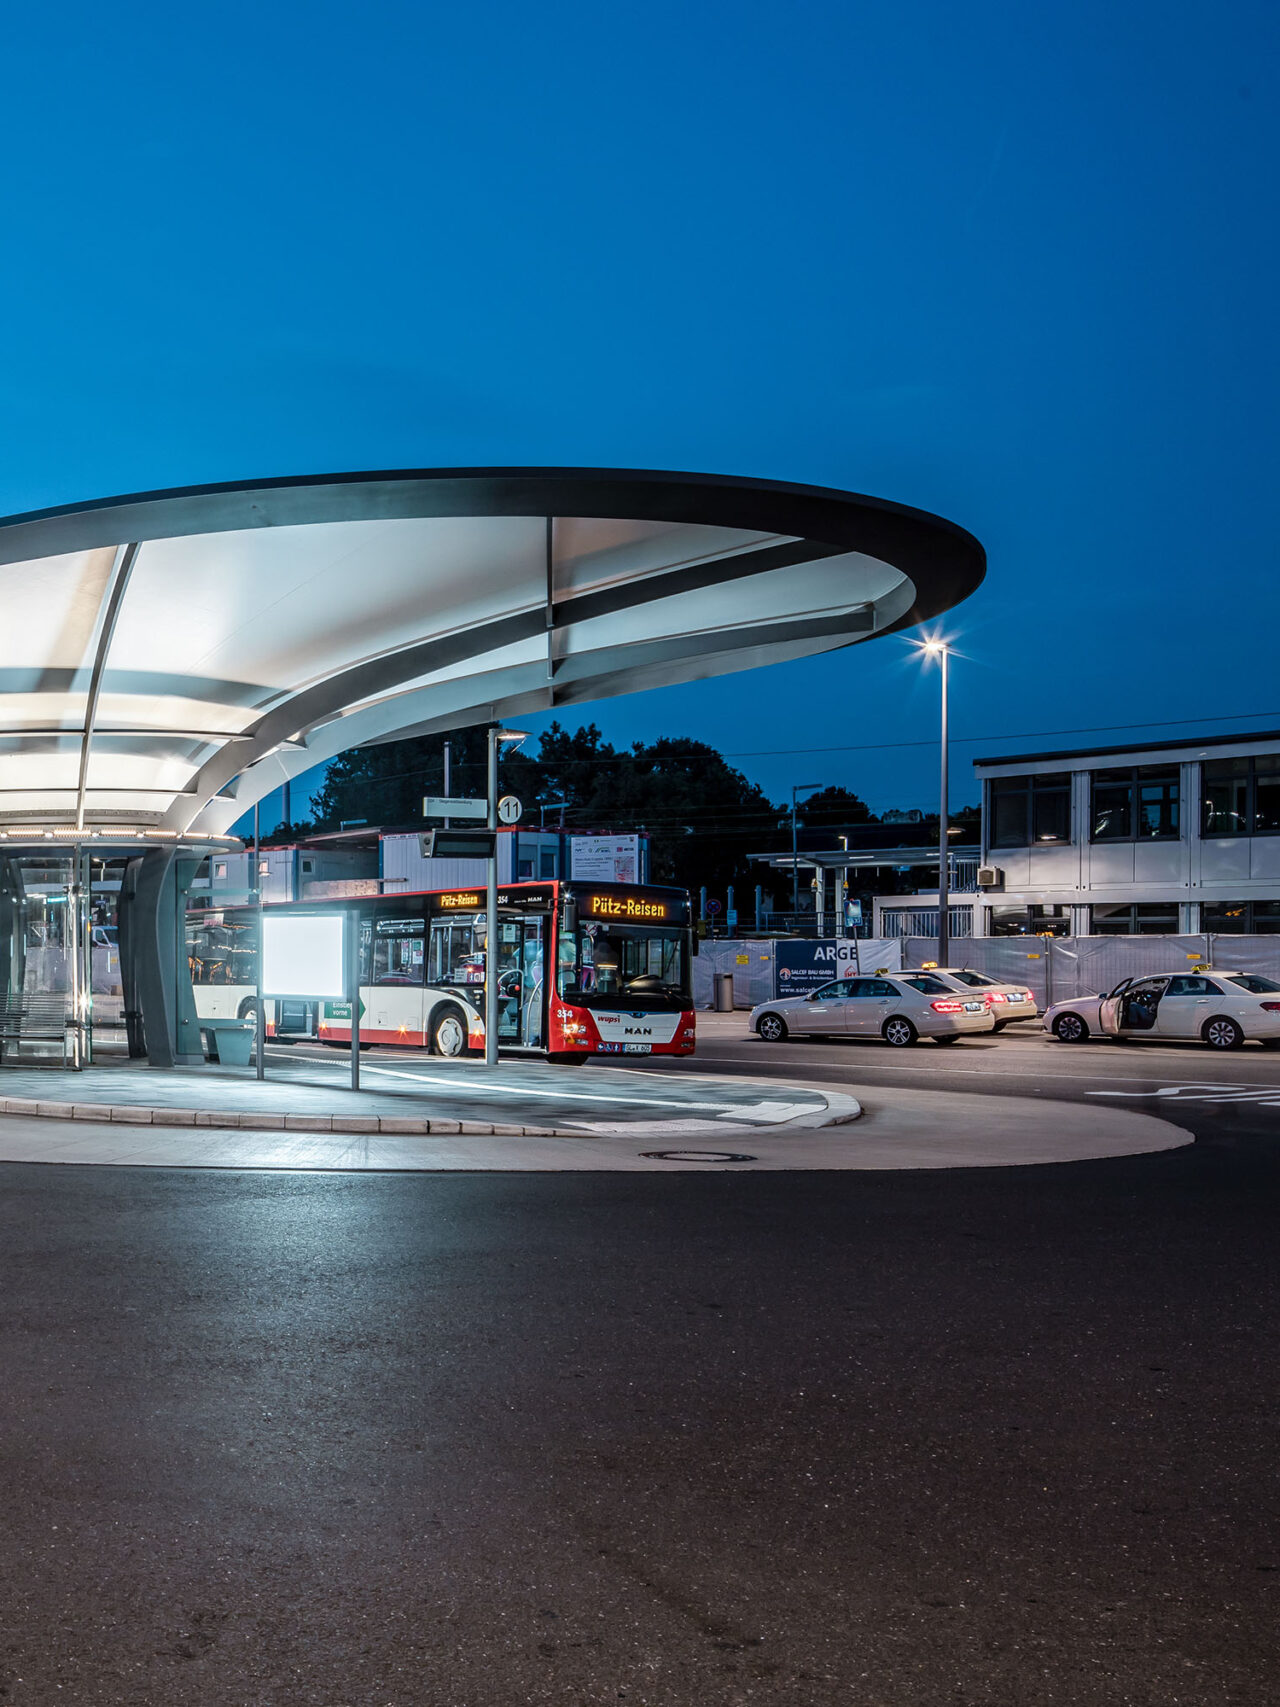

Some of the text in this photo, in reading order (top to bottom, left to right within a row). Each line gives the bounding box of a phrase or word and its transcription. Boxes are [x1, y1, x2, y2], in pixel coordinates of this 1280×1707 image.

[505, 802, 519, 818] 11
[441, 893, 478, 907] Pütz-Reisen
[497, 896, 509, 904] 354
[593, 896, 665, 917] Pütz-Reisen
[814, 946, 857, 961] ARGE
[557, 1009, 573, 1018] 354
[597, 1015, 621, 1024] wupsi
[624, 1027, 652, 1035] MAN
